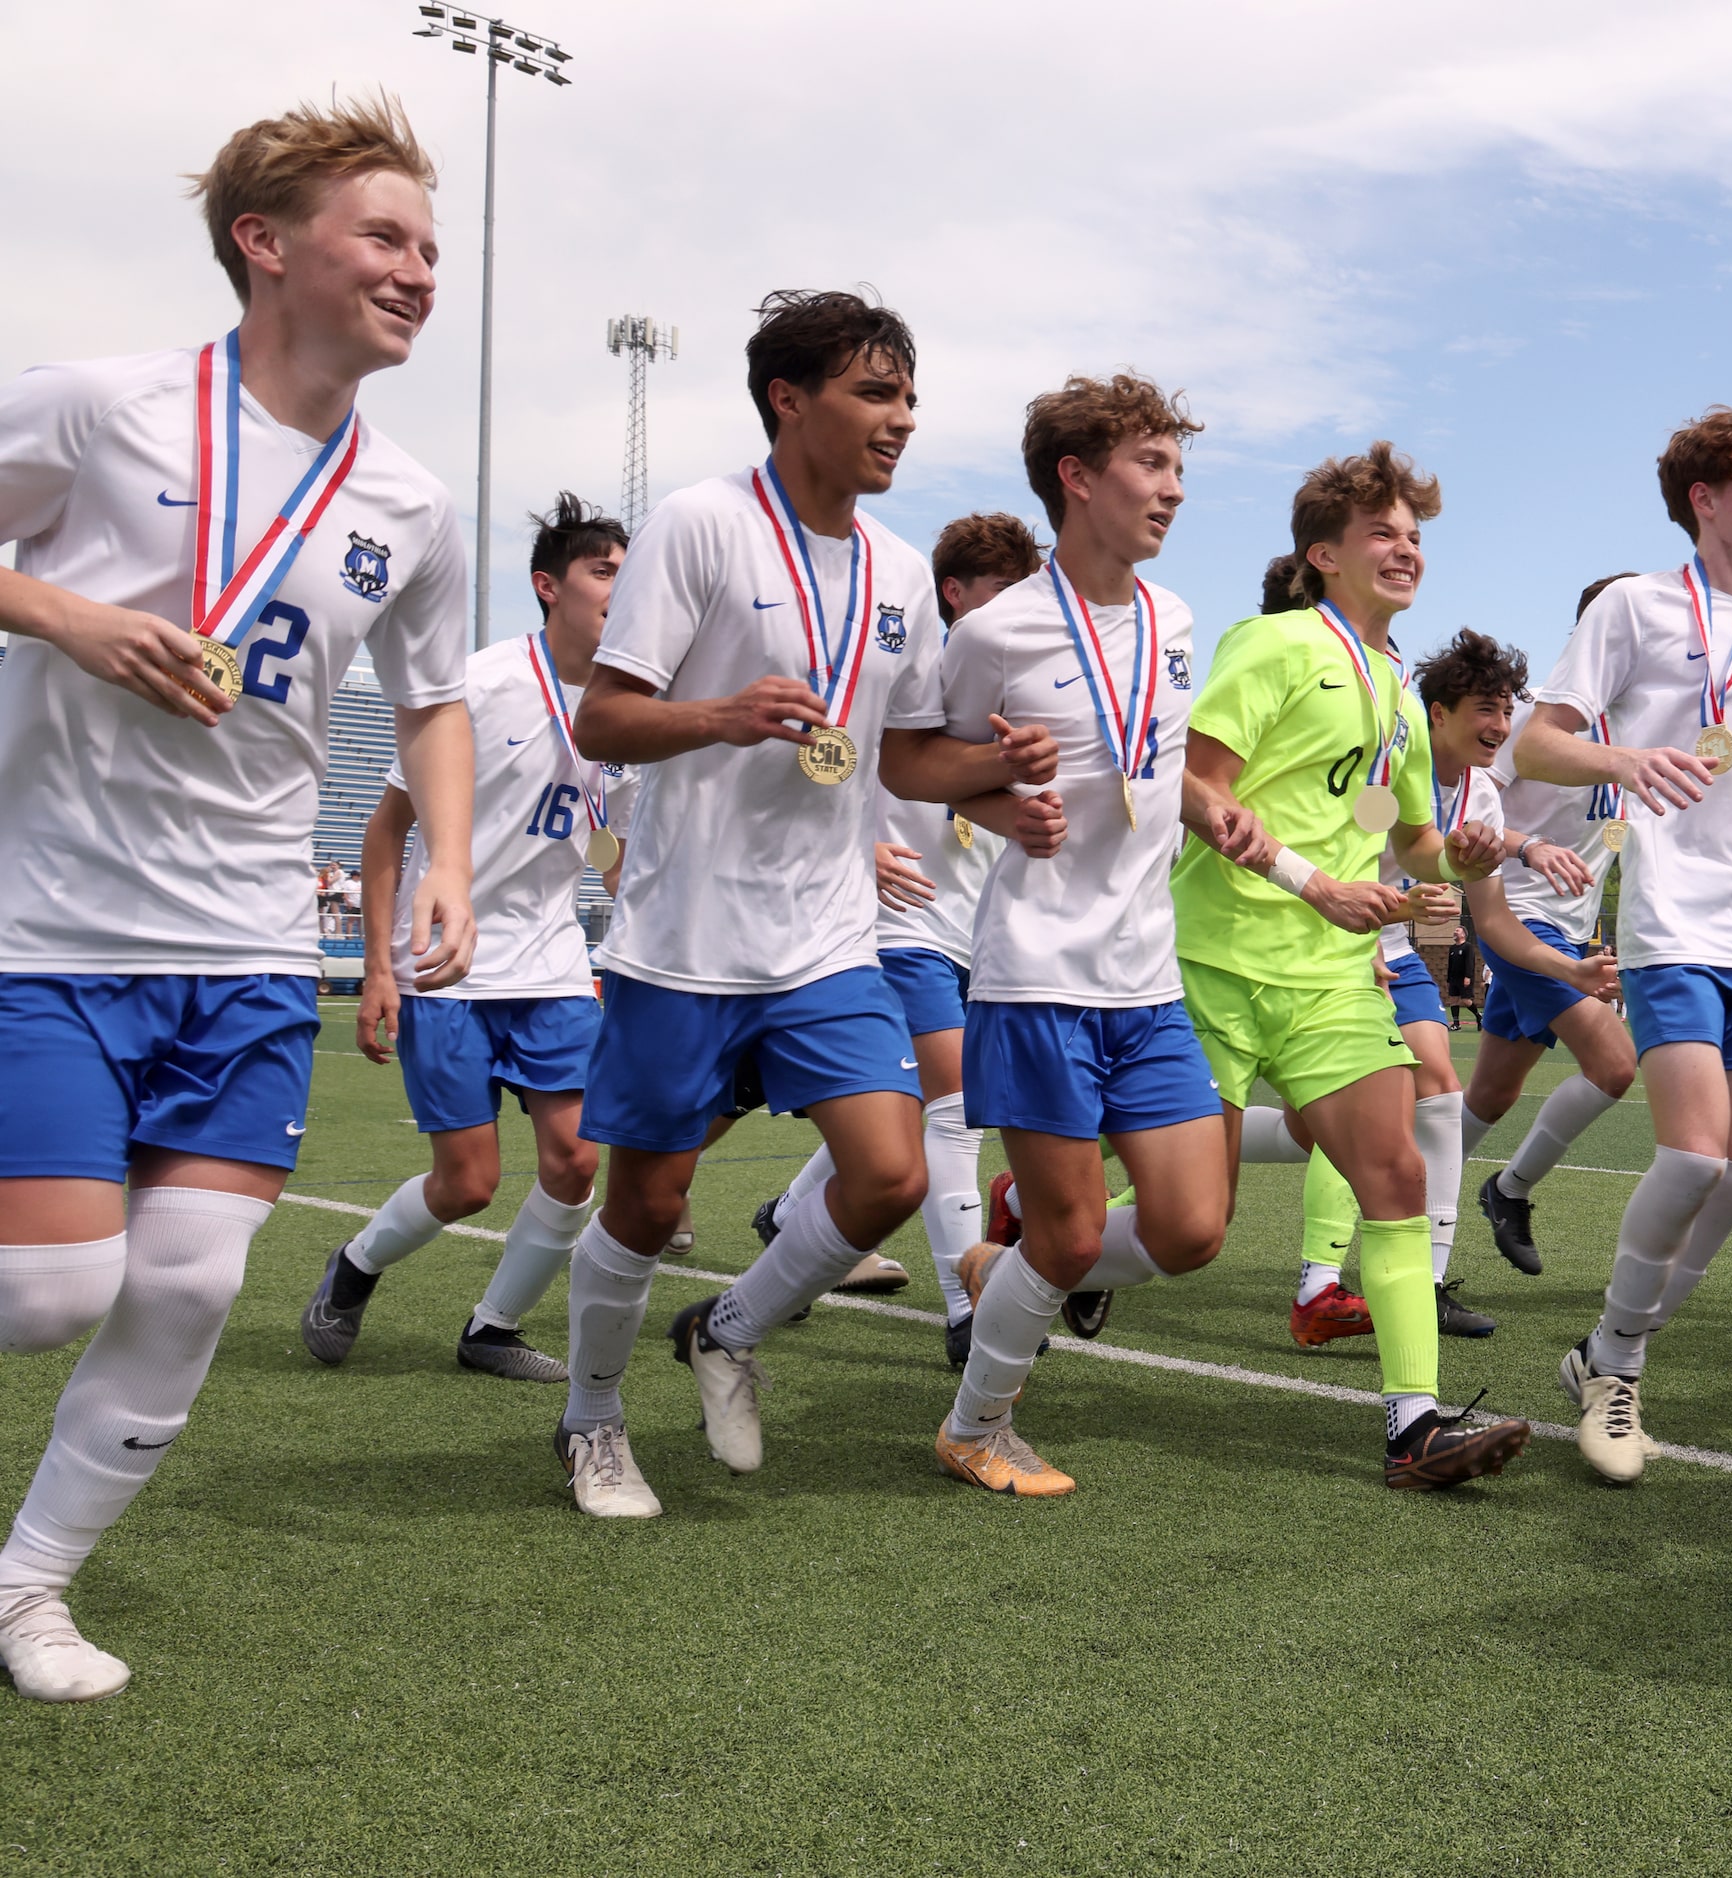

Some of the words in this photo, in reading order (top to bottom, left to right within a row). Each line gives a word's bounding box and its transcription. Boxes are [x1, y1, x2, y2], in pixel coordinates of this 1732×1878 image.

[242, 599, 311, 705] 2
[814, 764, 839, 774] STATE
[1326, 746, 1364, 798] 0
[526, 782, 580, 841] 16
